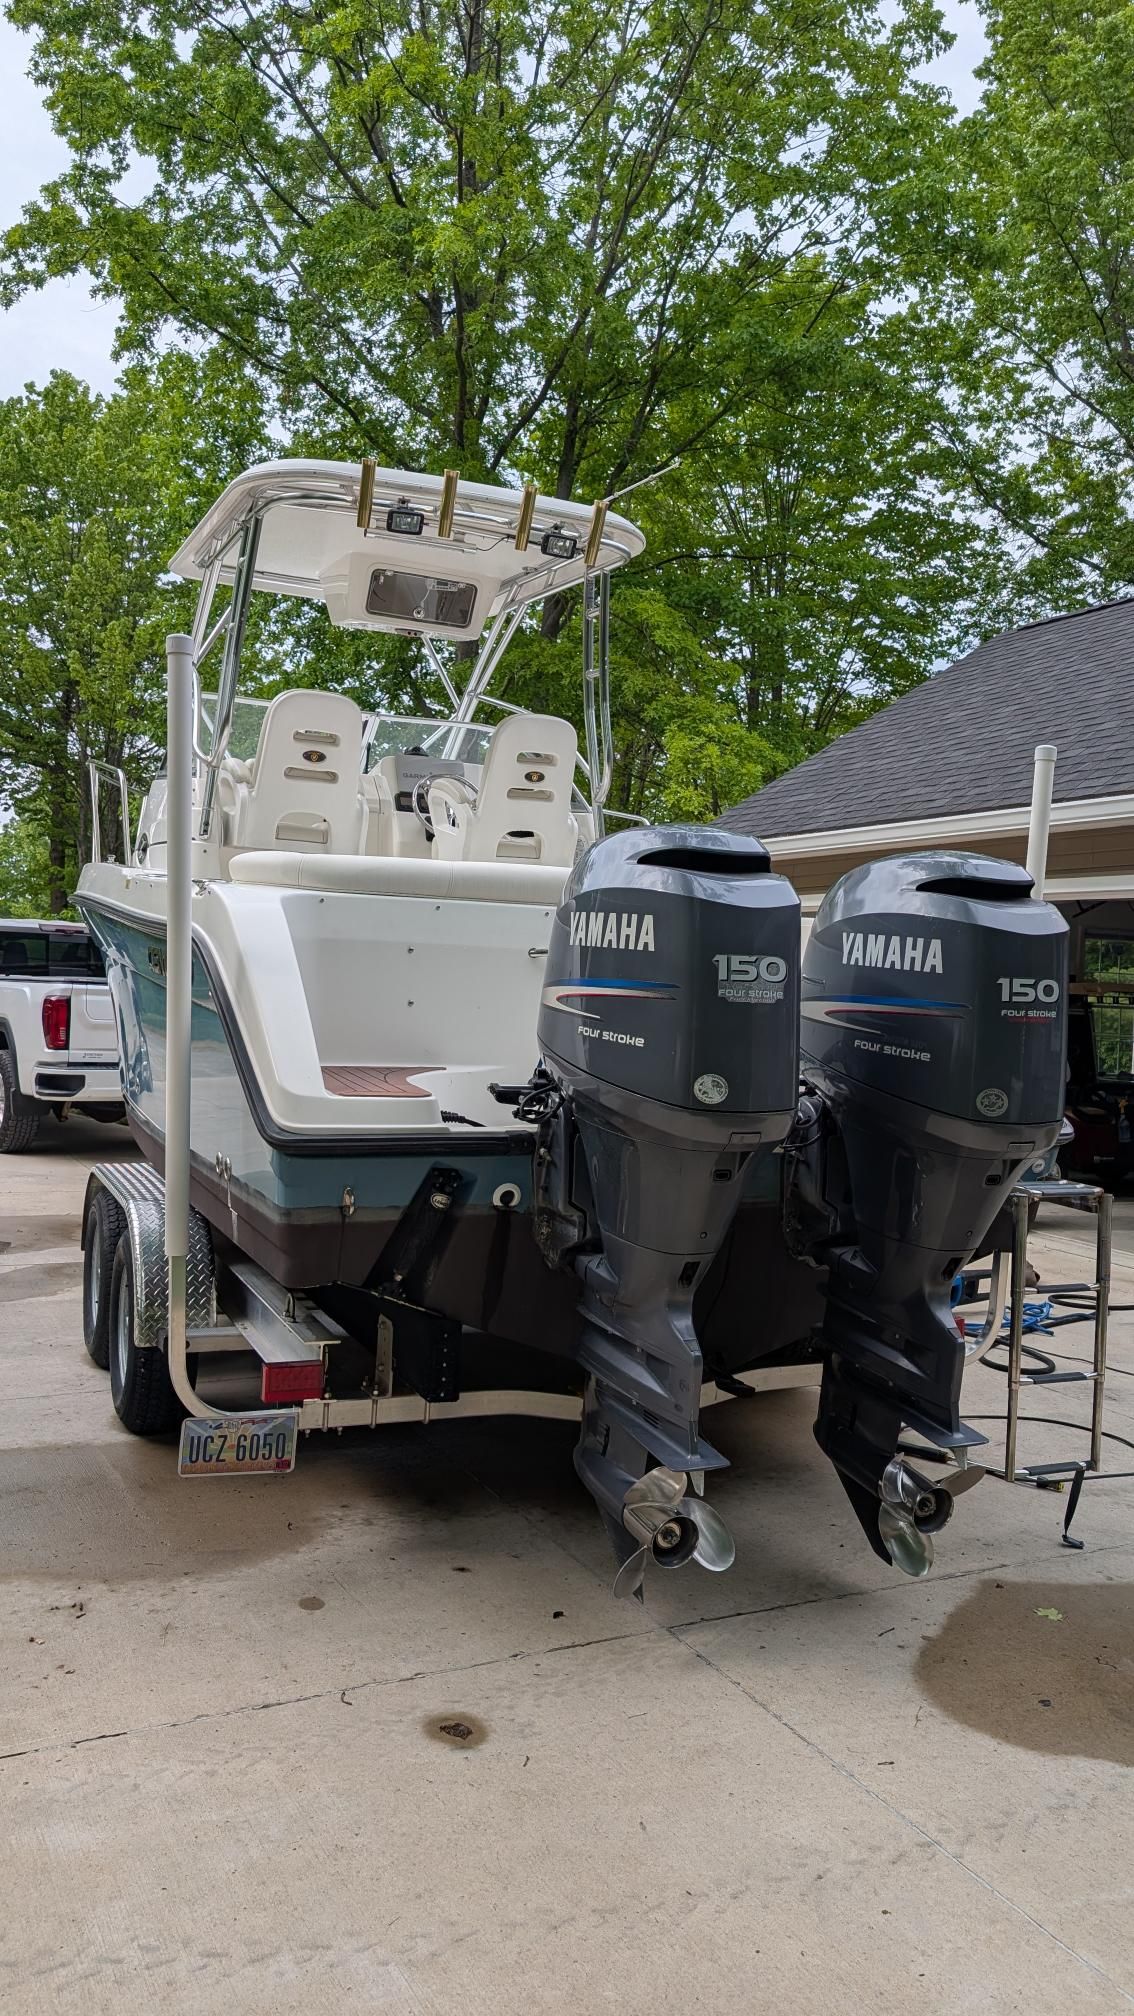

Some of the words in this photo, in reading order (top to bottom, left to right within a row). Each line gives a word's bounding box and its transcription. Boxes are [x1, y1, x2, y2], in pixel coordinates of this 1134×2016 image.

[569, 911, 655, 952] YAMAHA
[712, 954, 787, 983] 150
[842, 932, 943, 974] YAMAHA
[996, 977, 1060, 1003] 150
[189, 1435, 228, 1464] UCZ
[235, 1432, 287, 1462] 6050
